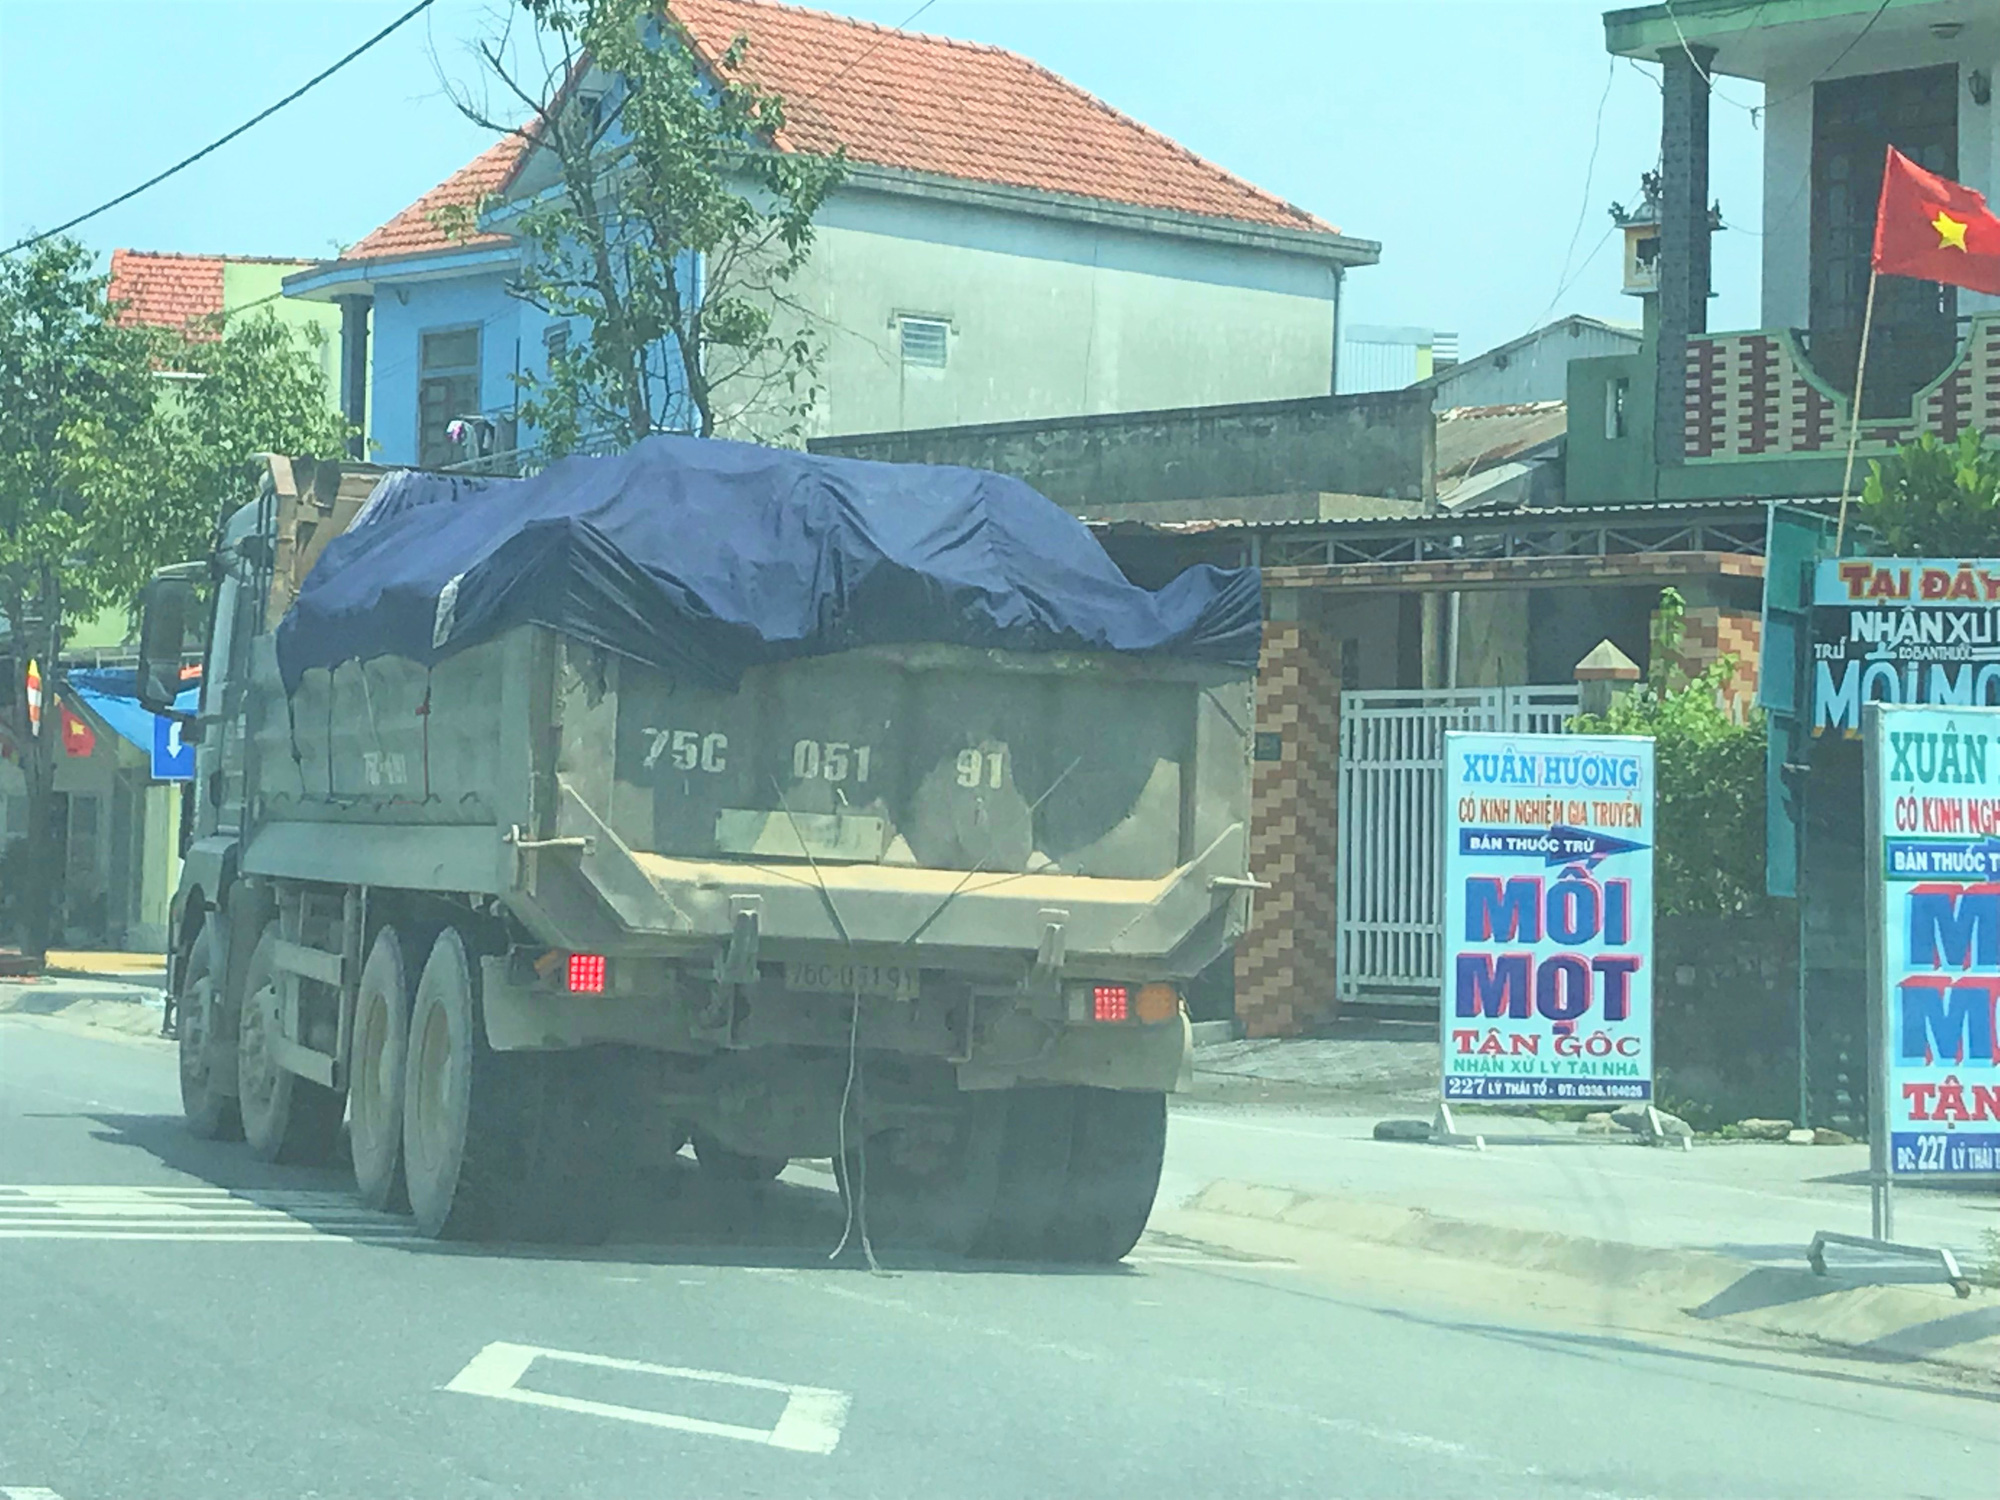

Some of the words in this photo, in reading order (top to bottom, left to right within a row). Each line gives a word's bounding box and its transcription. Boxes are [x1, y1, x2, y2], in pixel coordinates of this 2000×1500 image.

[1839, 562, 1911, 605] TẠI
[1851, 606, 1943, 646] NHẬN
[642, 728, 728, 772] 75C
[794, 739, 870, 782] 051
[957, 749, 1004, 789] 91
[1462, 746, 1536, 784] XUÂN
[1544, 755, 1638, 787] HƯƠNG
[1890, 720, 1987, 784] XUÂN
[1459, 791, 1476, 822] CÓ
[1480, 798, 1511, 822] KINH
[1515, 794, 1564, 829] NGHIỆM
[1568, 800, 1588, 826] GIA
[1896, 786, 1917, 832] CÓ
[1922, 797, 1963, 833] KINH
[1470, 834, 1502, 849] BÁN
[1506, 835, 1559, 852] THUỐC
[1895, 847, 1928, 871] BÁN
[1932, 845, 1986, 872] THUỐC
[1465, 857, 1631, 945] MỐI
[1456, 953, 1642, 1035] MỌT
[1453, 1028, 1540, 1059] TẬN
[1554, 1027, 1641, 1058] GỐC
[1449, 1078, 1486, 1095] 227
[1454, 1057, 1504, 1077] NHẬN
[1541, 1058, 1560, 1074] LÝ
[1568, 1061, 1597, 1079] TẠI
[1603, 1058, 1640, 1076] NHÀ
[1902, 1075, 2000, 1129] TẬN
[1917, 1135, 1947, 1170] 227
[1952, 1142, 1966, 1170] LÝ
[1968, 1142, 1993, 1170] THÁI
